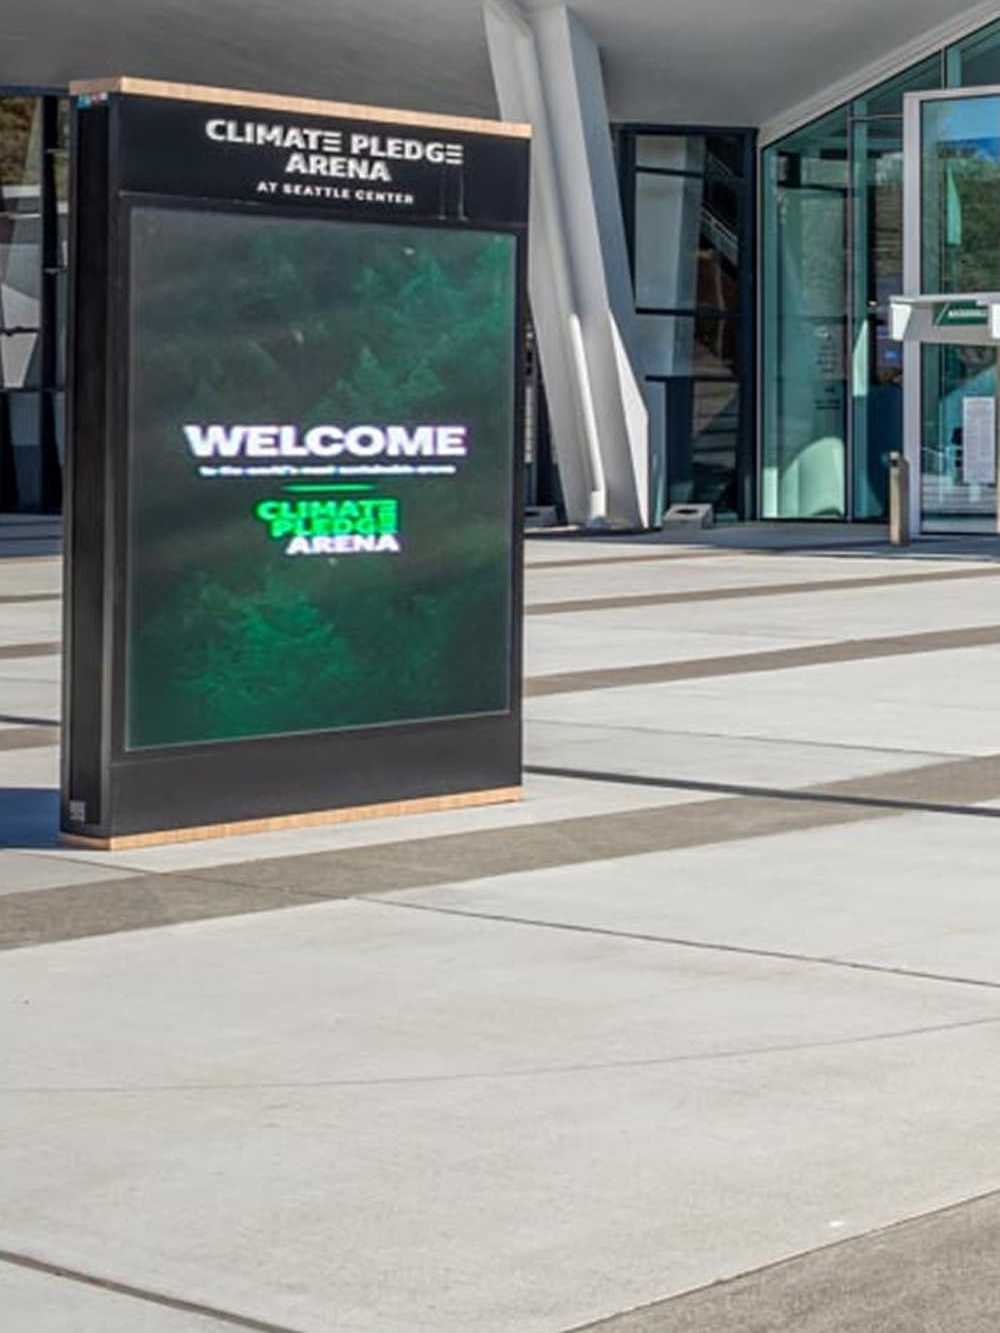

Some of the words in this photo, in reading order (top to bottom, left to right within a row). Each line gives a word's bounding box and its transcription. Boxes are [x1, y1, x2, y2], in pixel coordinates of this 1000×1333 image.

[205, 119, 341, 152] CLIMATE
[350, 134, 463, 164] PLEDGE
[284, 152, 392, 181] ARENA
[256, 181, 276, 194] AT
[283, 184, 350, 199] SEATTLE
[355, 189, 414, 204] CENTER
[183, 425, 467, 457] WELCOME
[256, 499, 398, 520] CLIMATE
[270, 518, 398, 538] PLEDGE
[285, 534, 400, 555] ARENA
